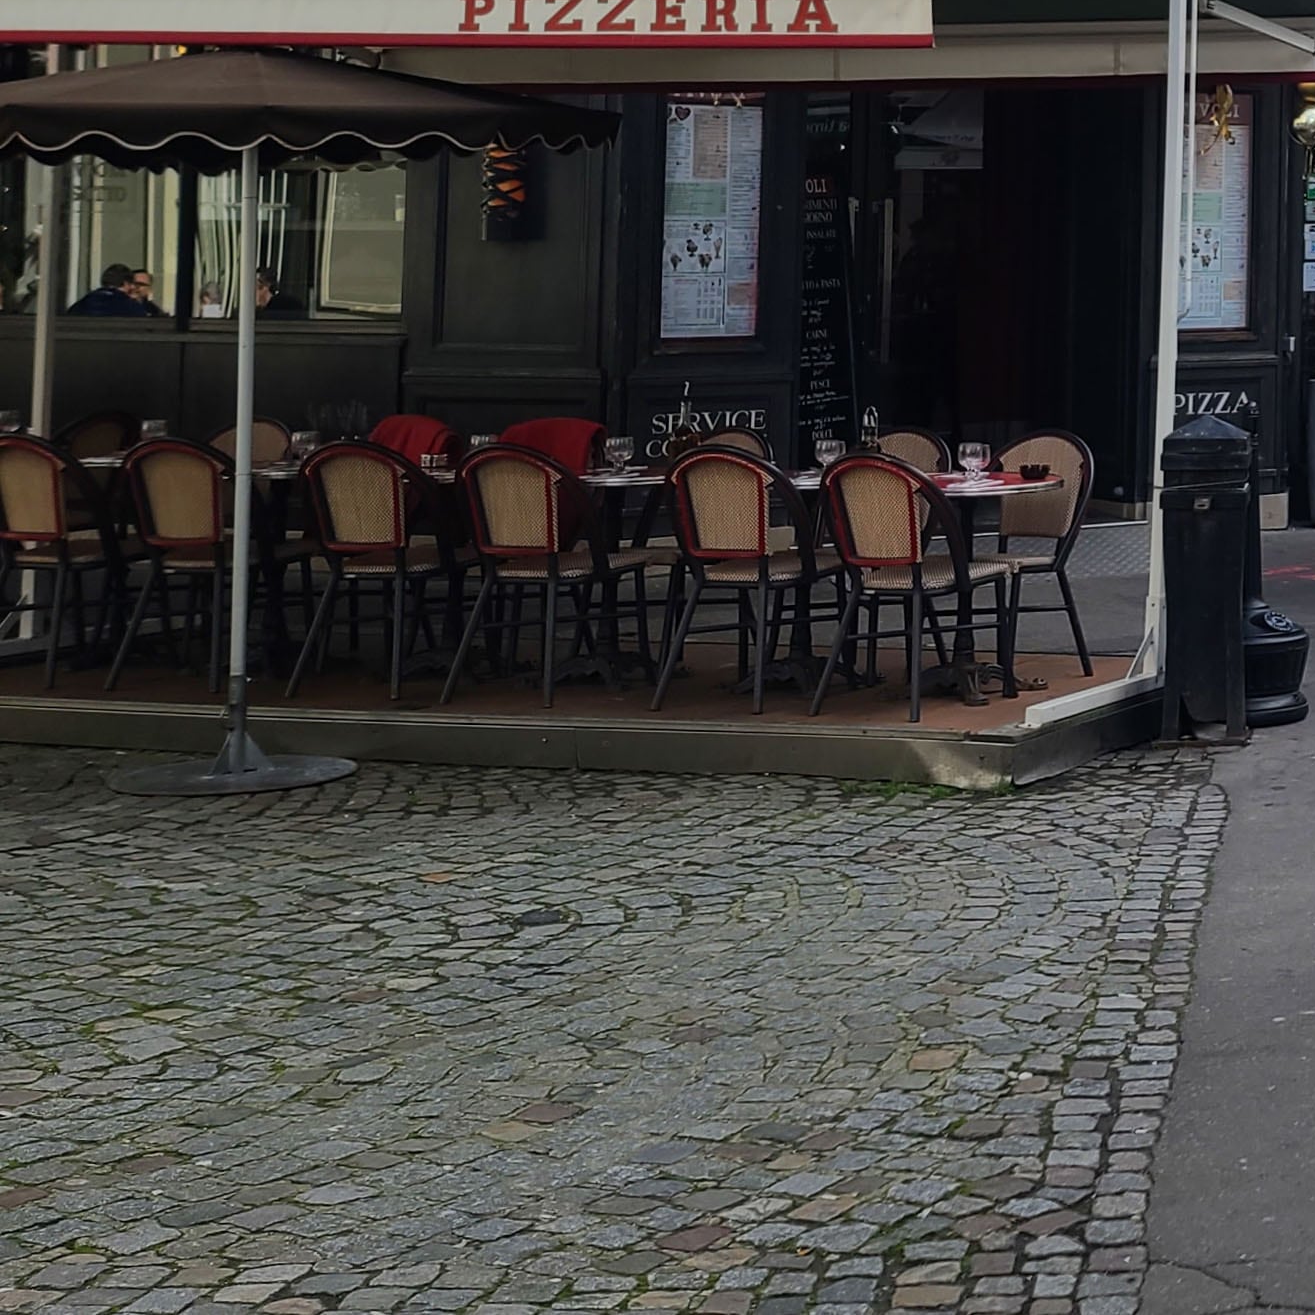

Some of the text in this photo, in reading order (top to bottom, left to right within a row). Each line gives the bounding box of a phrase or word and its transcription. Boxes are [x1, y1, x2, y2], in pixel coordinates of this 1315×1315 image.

[805, 179, 826, 193] OLI
[1174, 391, 1248, 415] PIZZA
[651, 409, 766, 434] SERVICE
